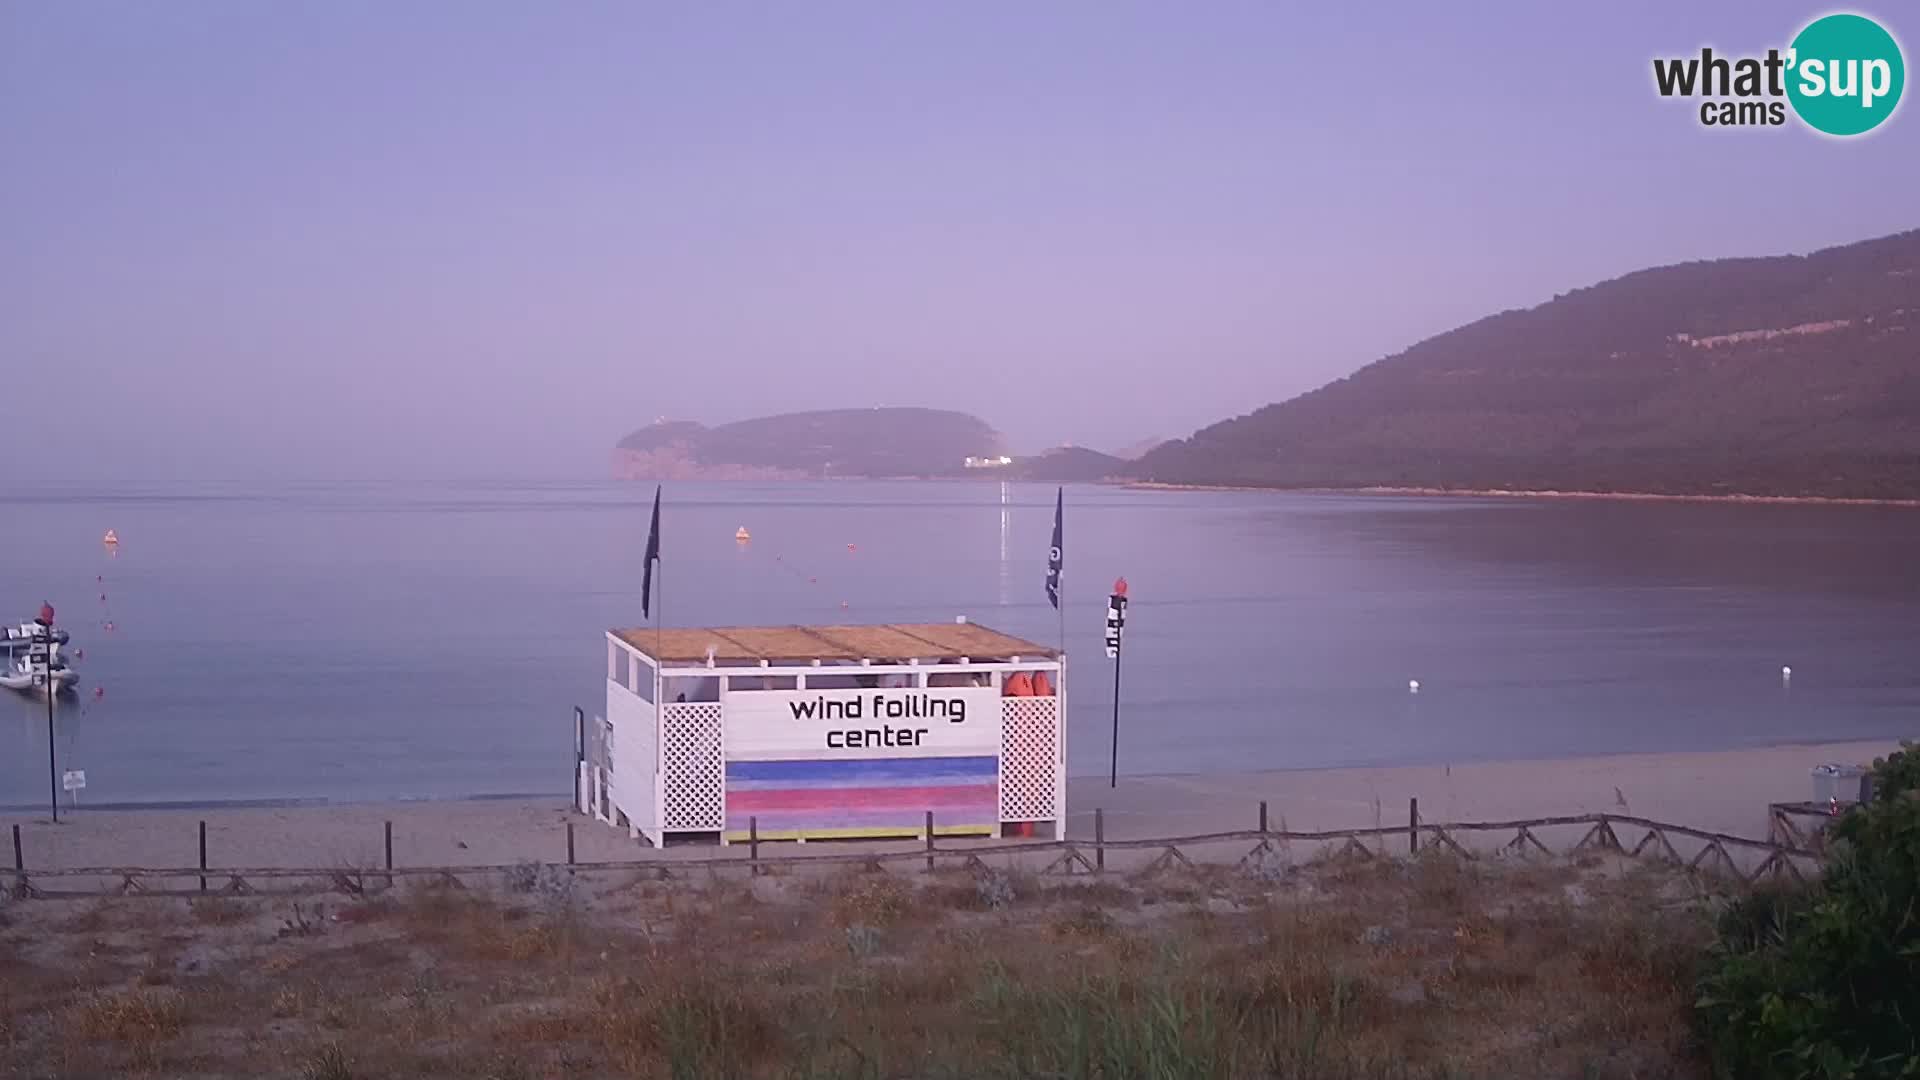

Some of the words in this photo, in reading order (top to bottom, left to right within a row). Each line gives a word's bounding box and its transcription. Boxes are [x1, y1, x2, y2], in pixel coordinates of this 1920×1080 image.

[789, 695, 863, 720] wind
[873, 694, 966, 723] foiling
[827, 725, 929, 748] center
